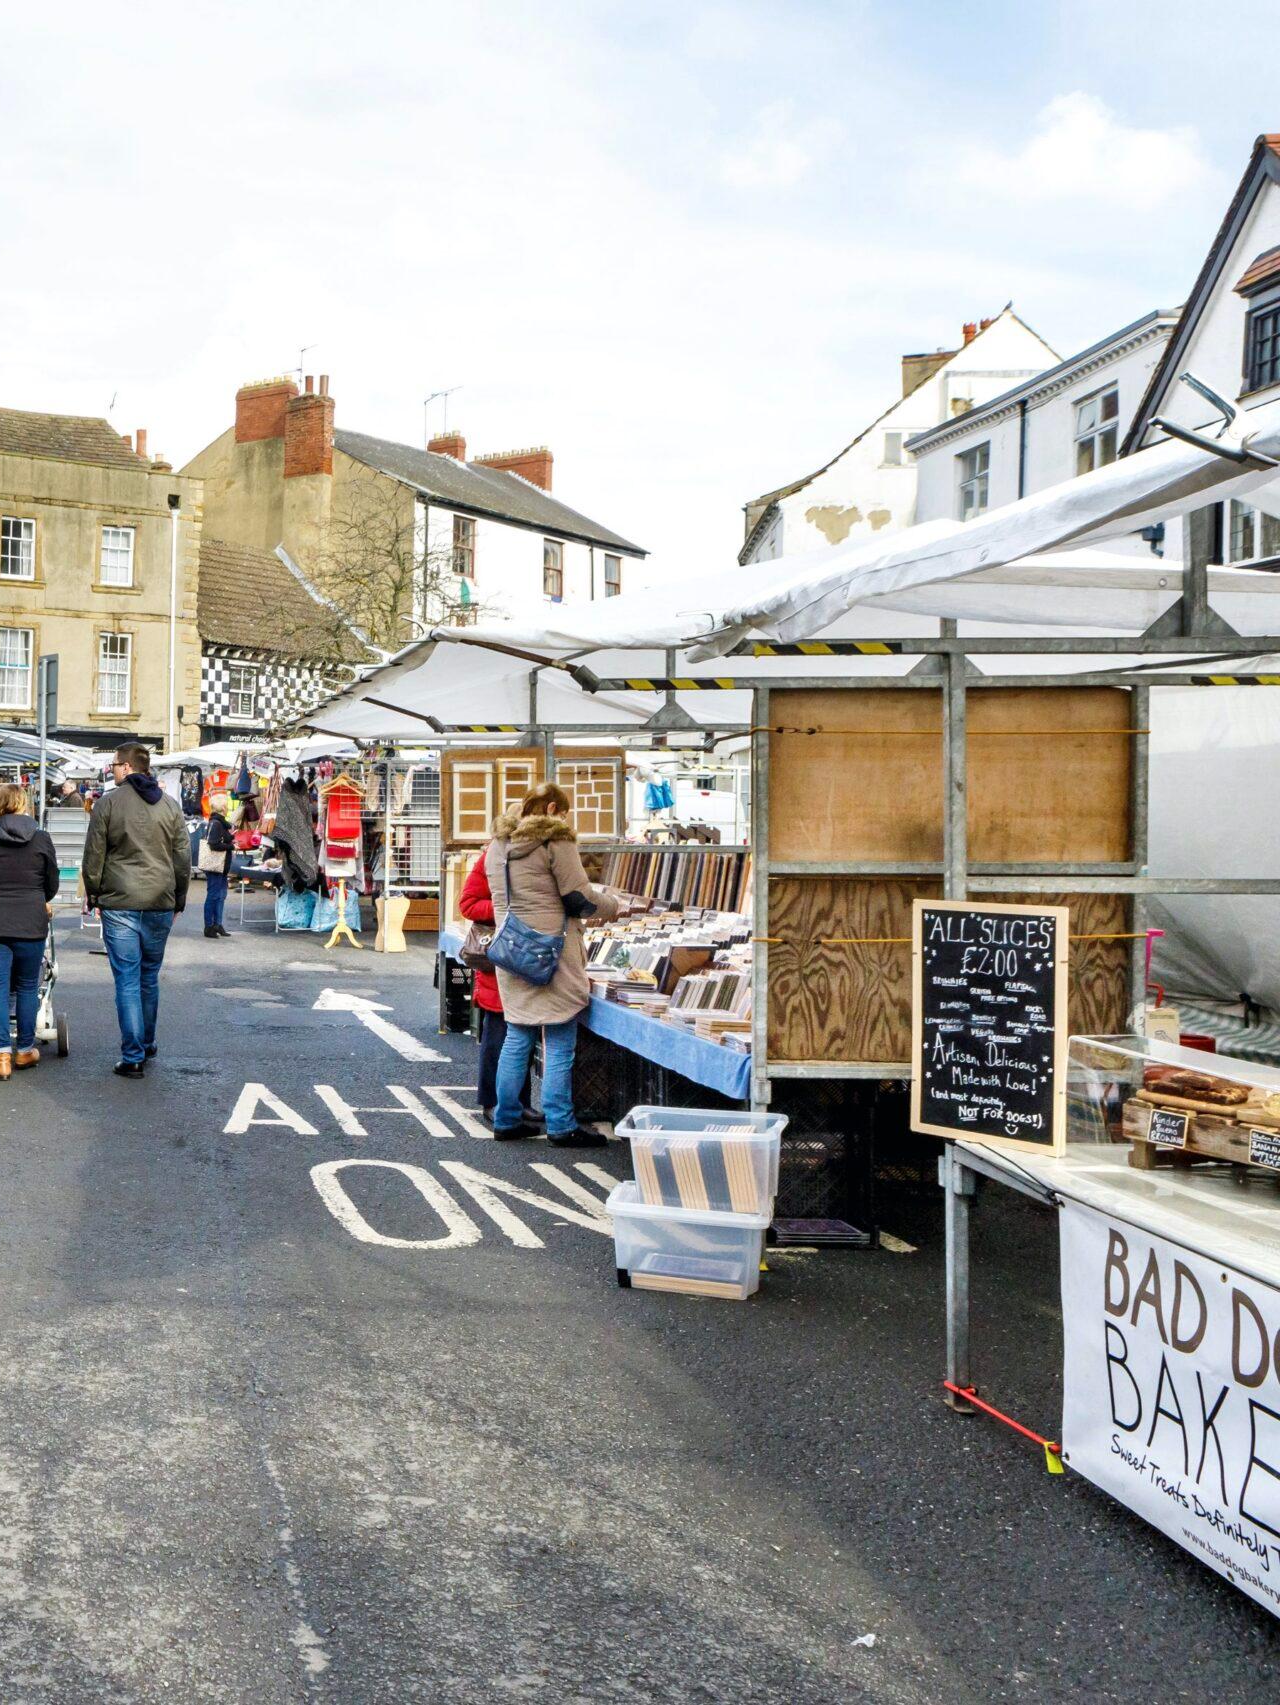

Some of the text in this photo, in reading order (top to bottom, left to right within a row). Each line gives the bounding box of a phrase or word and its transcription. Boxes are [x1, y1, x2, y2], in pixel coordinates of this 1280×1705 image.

[229, 734, 252, 742] natural
[928, 915, 1052, 950] ALL SLICES
[984, 1041, 1038, 1073] Delicious
[951, 1066, 1037, 1096] Made with Love!
[950, 1093, 969, 1102] most
[957, 1105, 980, 1119] NOT
[982, 1107, 1005, 1120] FOR
[1153, 1112, 1185, 1127] Kinder
[1150, 1129, 1185, 1146] BROWNIE
[1155, 1123, 1179, 1136] Bueno
[1104, 1227, 1280, 1388] BAD D
[1111, 1433, 1270, 1572] Sweet Treats Definitely
